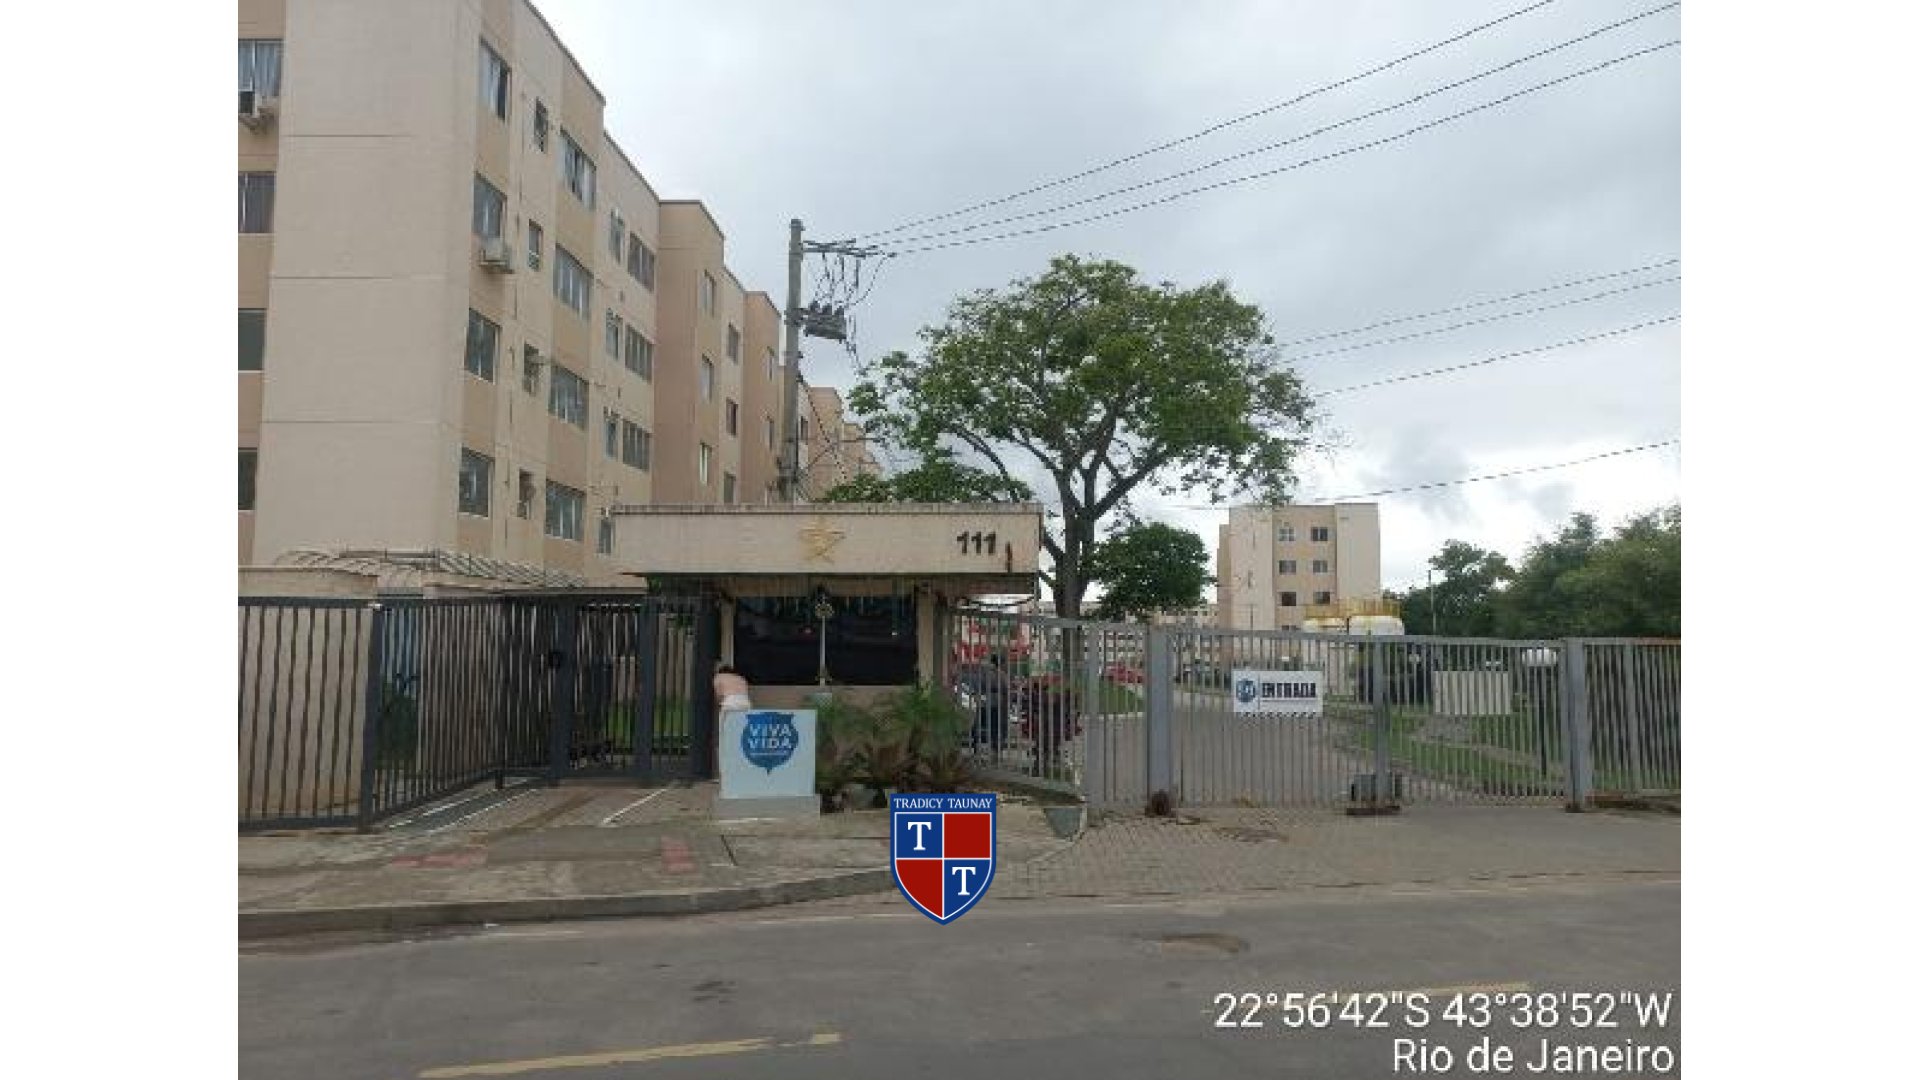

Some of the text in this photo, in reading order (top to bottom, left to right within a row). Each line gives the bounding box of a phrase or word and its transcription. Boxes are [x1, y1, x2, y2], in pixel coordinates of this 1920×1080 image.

[956, 531, 997, 555] 111
[748, 723, 792, 737] VIVA
[748, 737, 793, 749] VIDA
